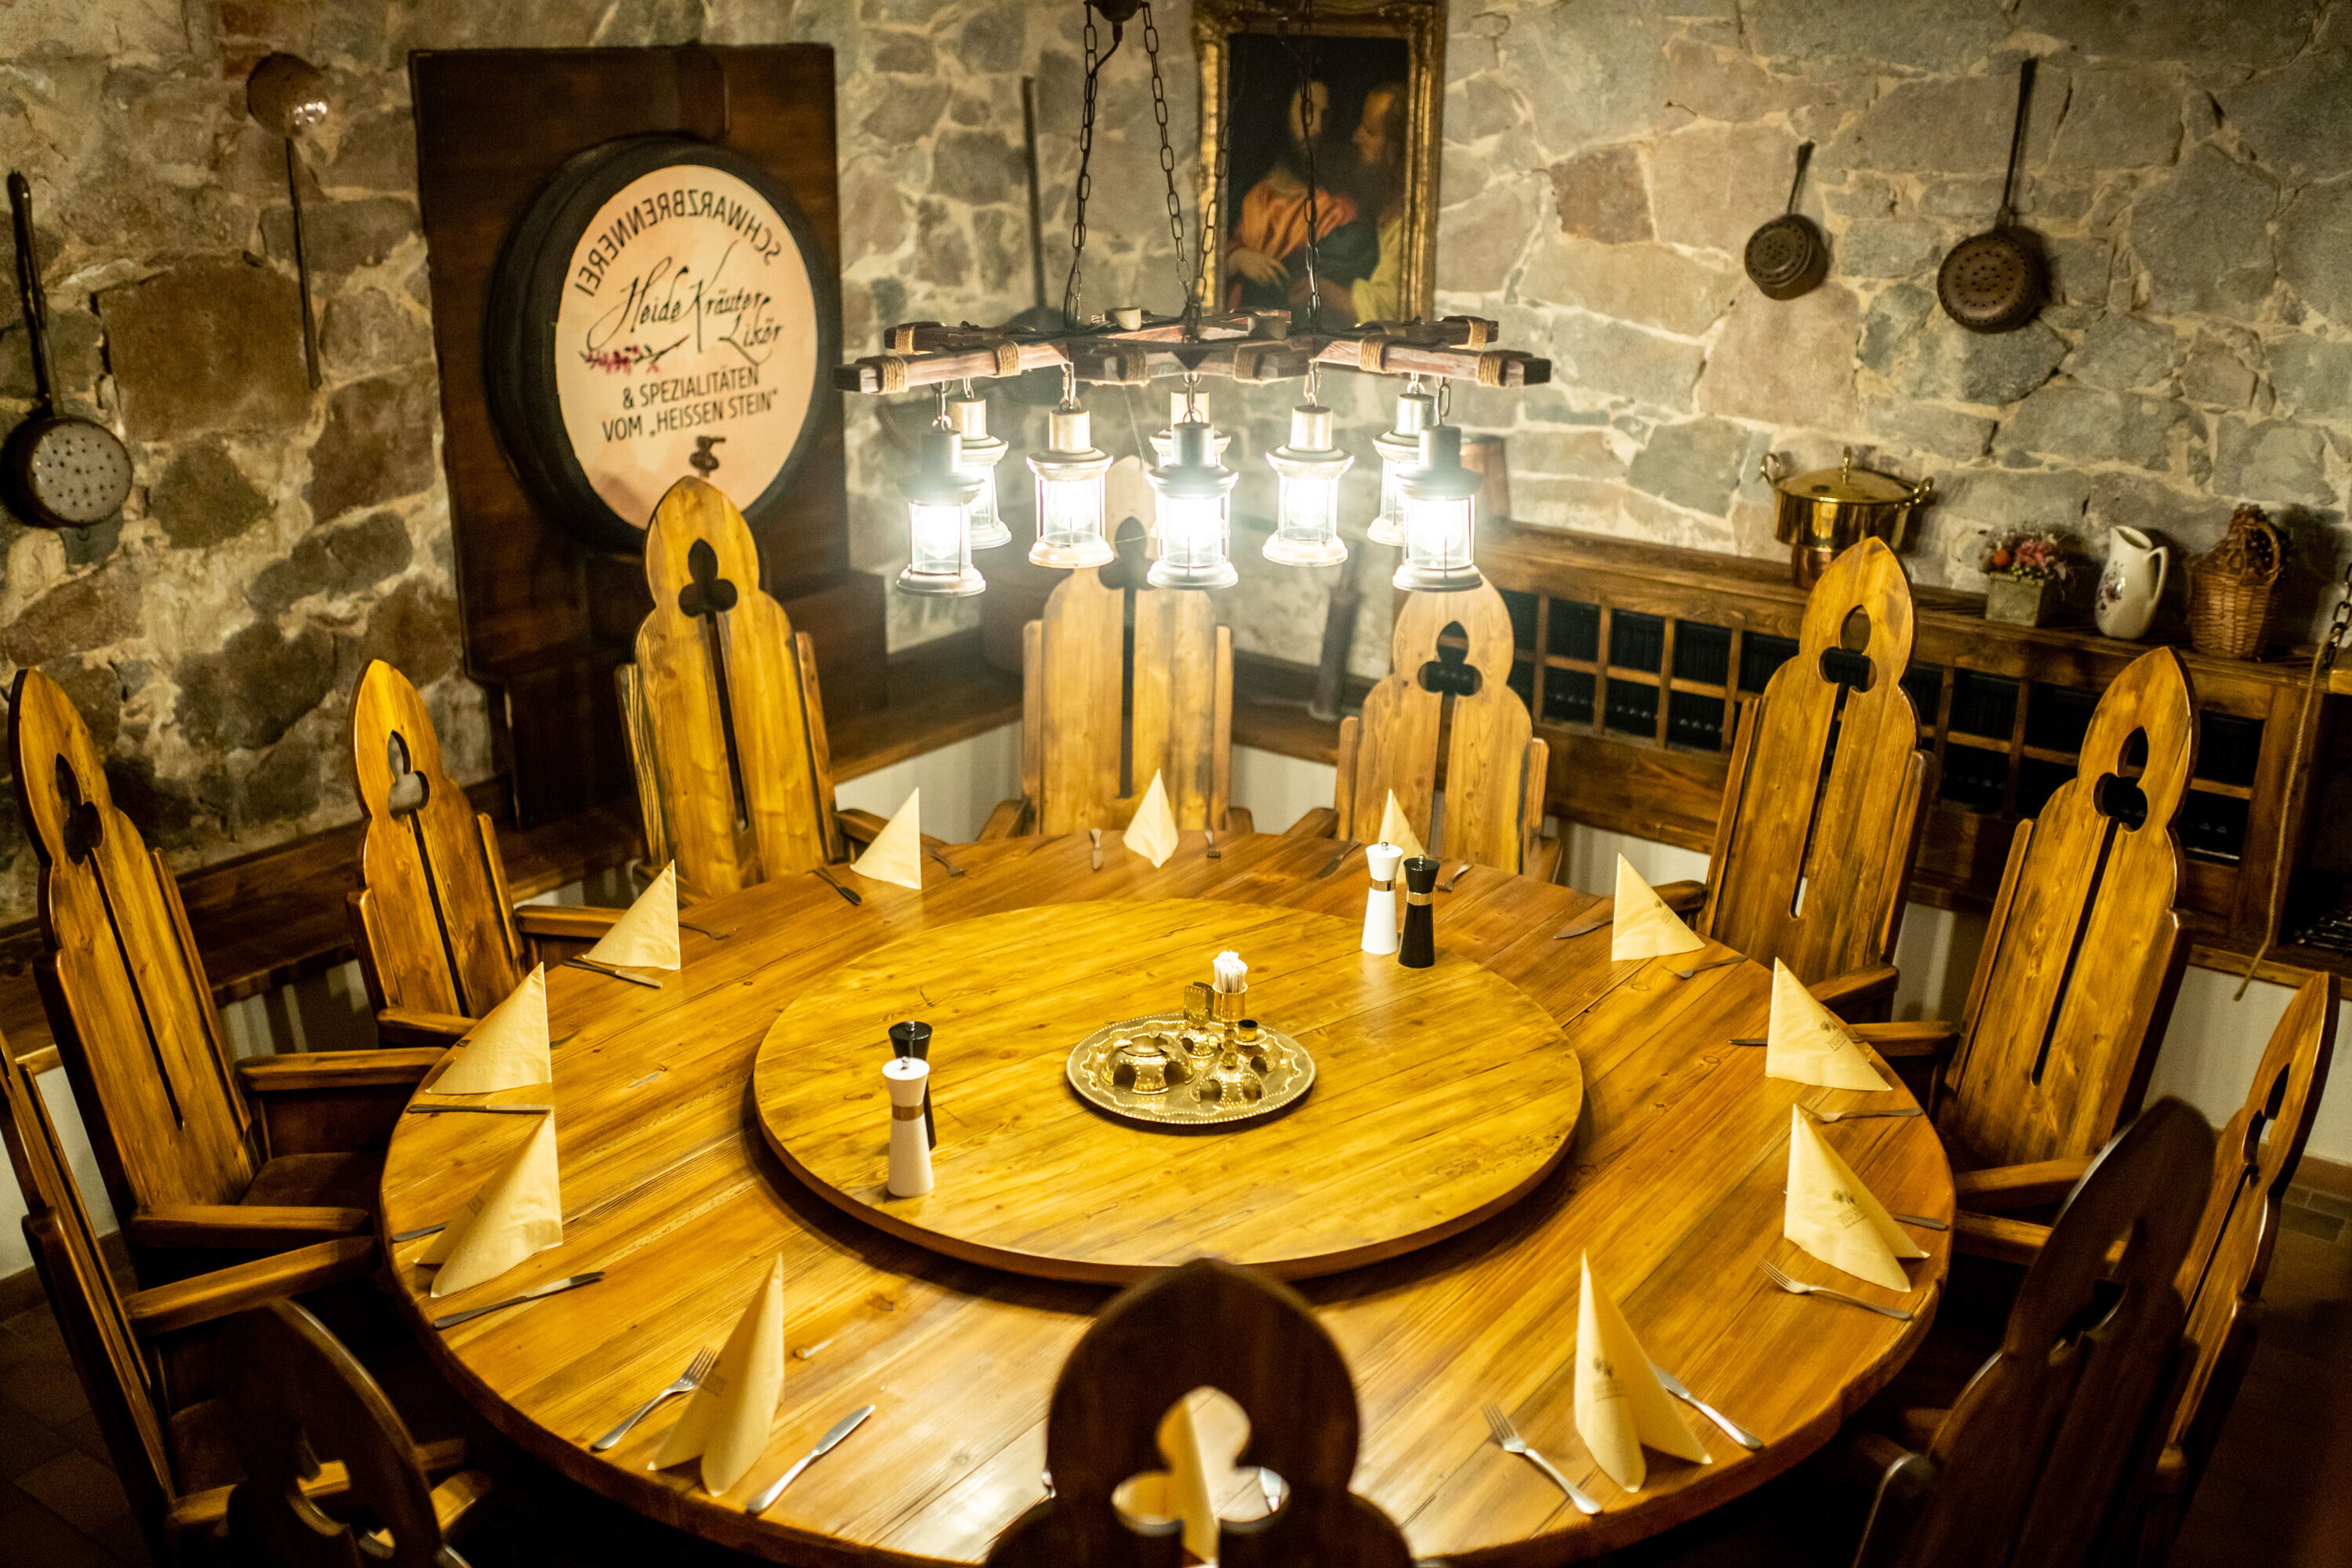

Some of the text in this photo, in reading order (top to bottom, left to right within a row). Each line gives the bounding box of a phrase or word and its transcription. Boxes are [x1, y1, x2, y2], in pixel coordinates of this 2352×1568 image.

[586, 239, 766, 354] Heide Kräuter
[718, 296, 782, 366] Likör
[622, 365, 759, 410] & SPEZIALITÄTEN
[602, 415, 642, 443] VOM
